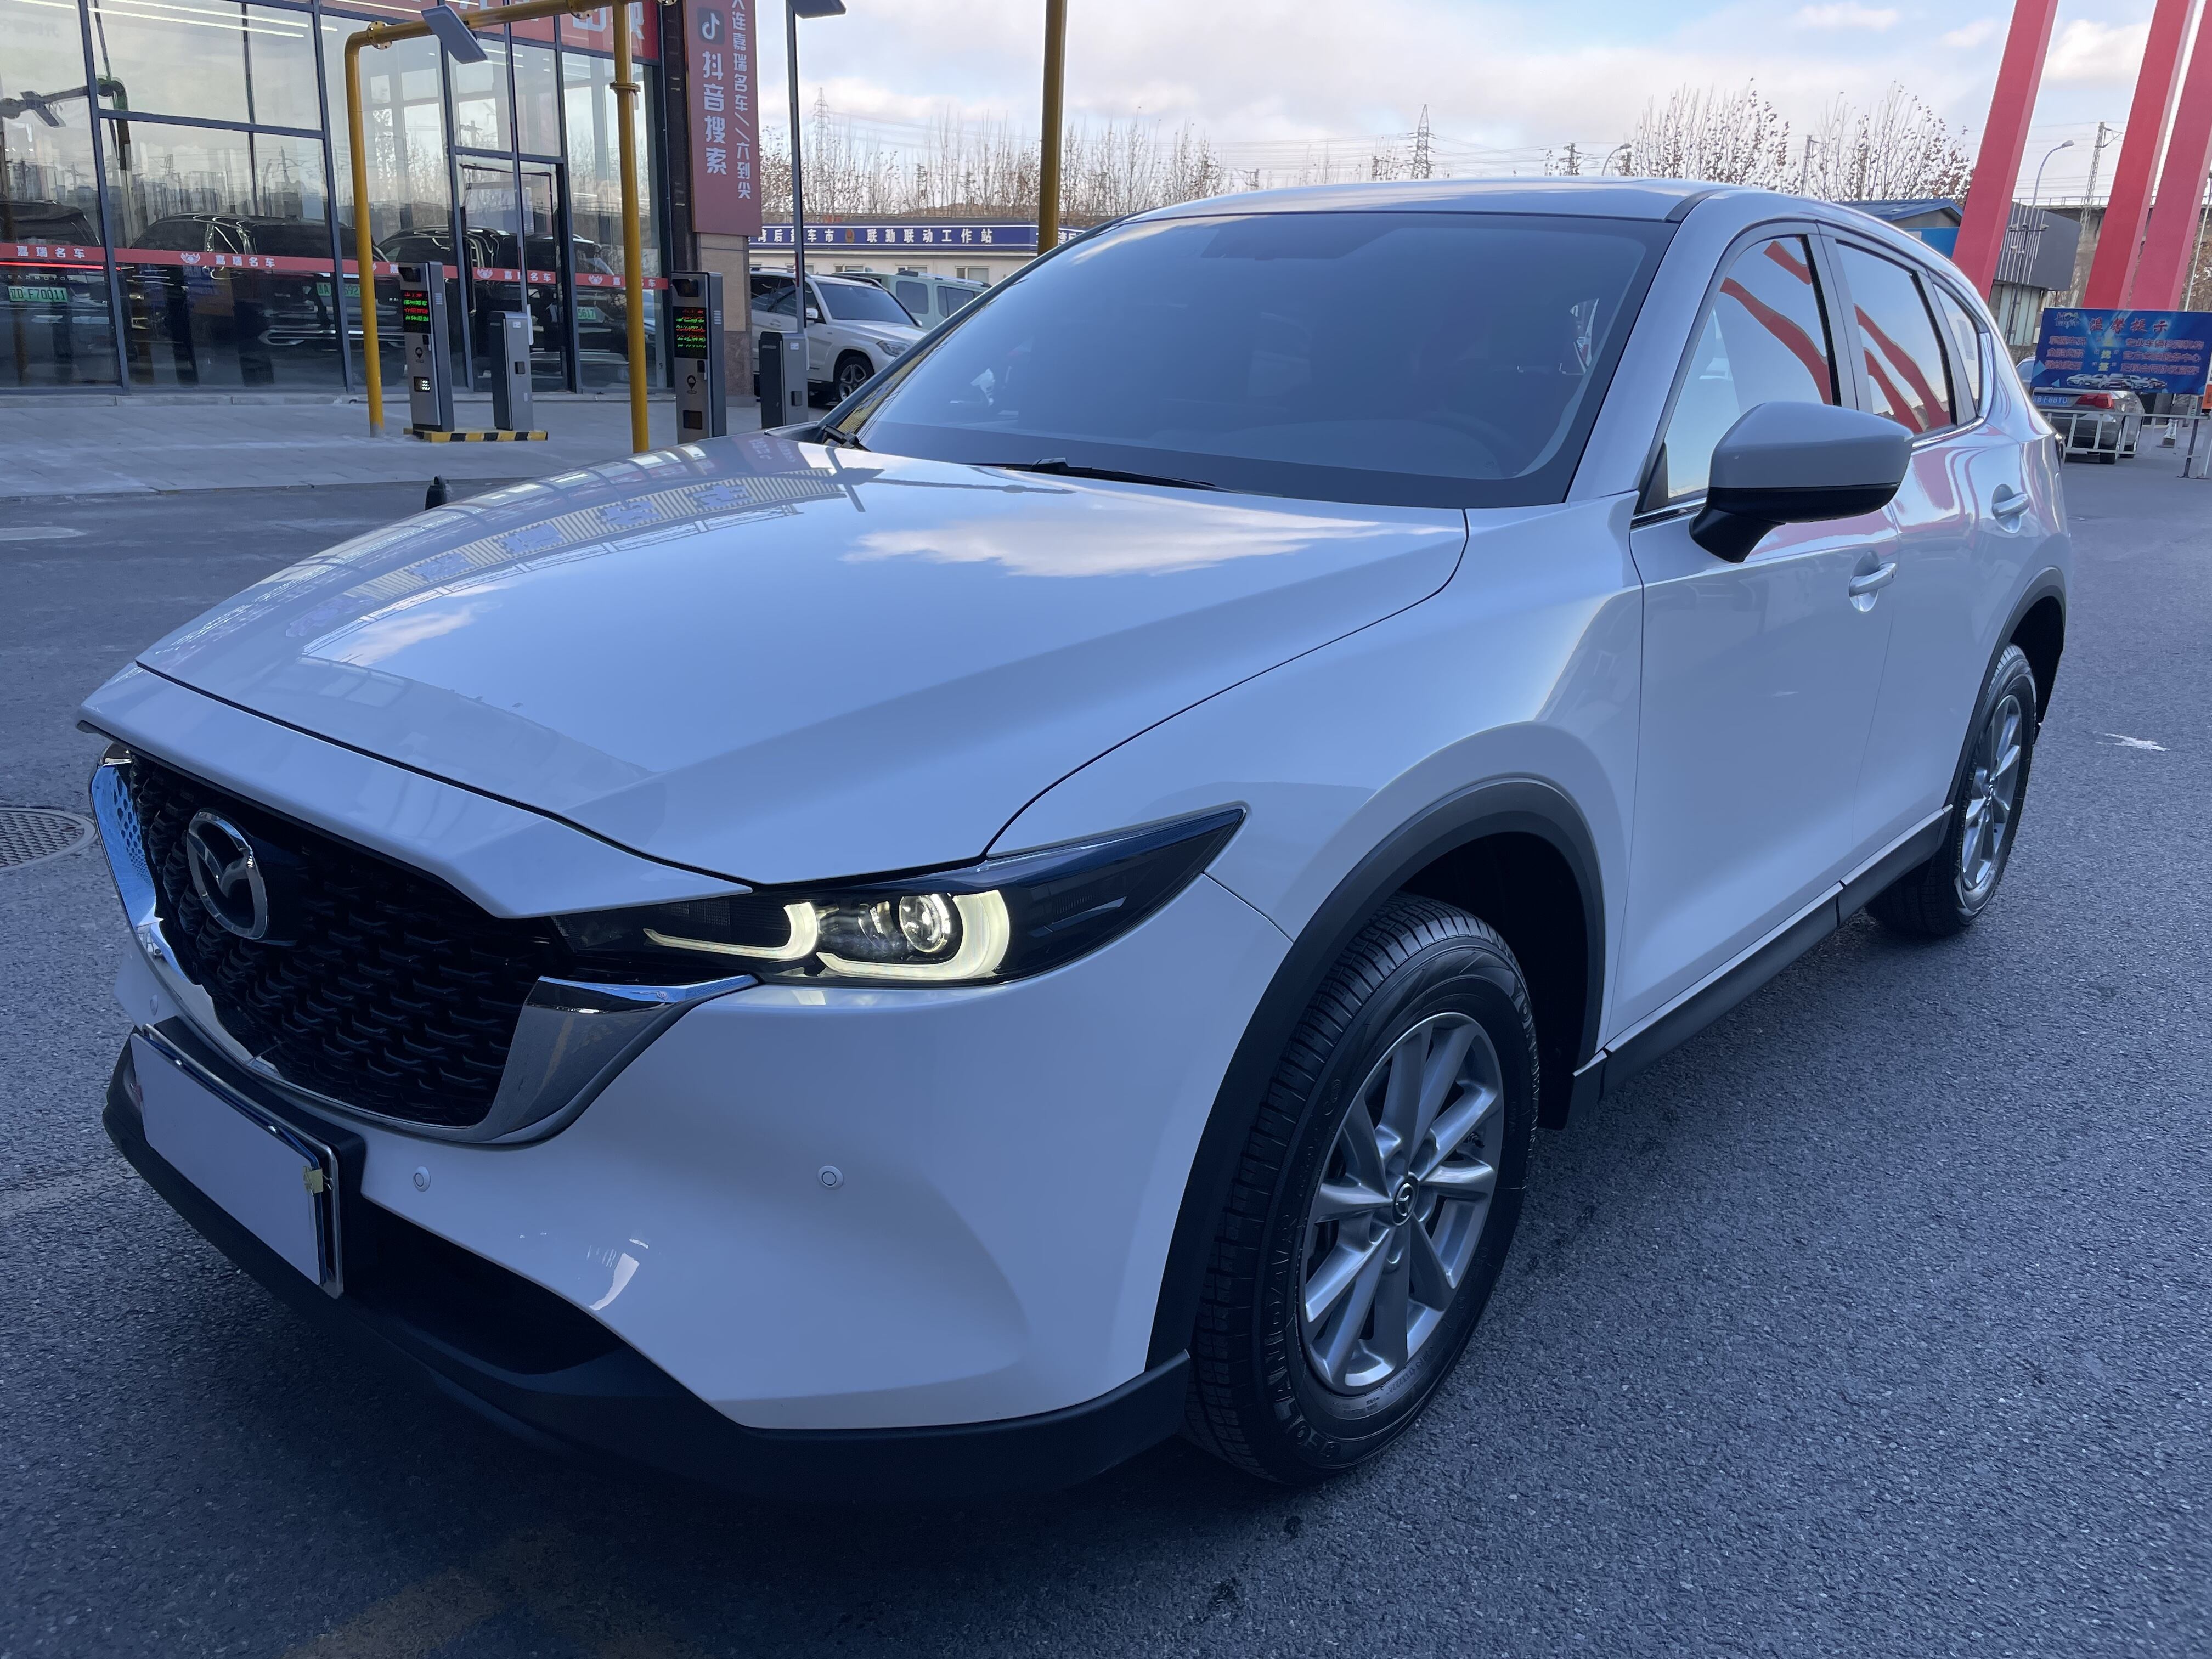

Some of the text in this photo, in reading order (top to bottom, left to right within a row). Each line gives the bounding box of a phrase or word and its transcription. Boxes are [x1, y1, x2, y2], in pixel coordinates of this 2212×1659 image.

[702, 51, 727, 175] 抖音搜索
[867, 228, 992, 243] 联勤联动工作站
[16, 246, 86, 259] 嘉瑞名车
[215, 255, 275, 268] 嘉瑞名车
[504, 271, 551, 282] 嘉名车
[2089, 317, 2168, 334] 温馨提示
